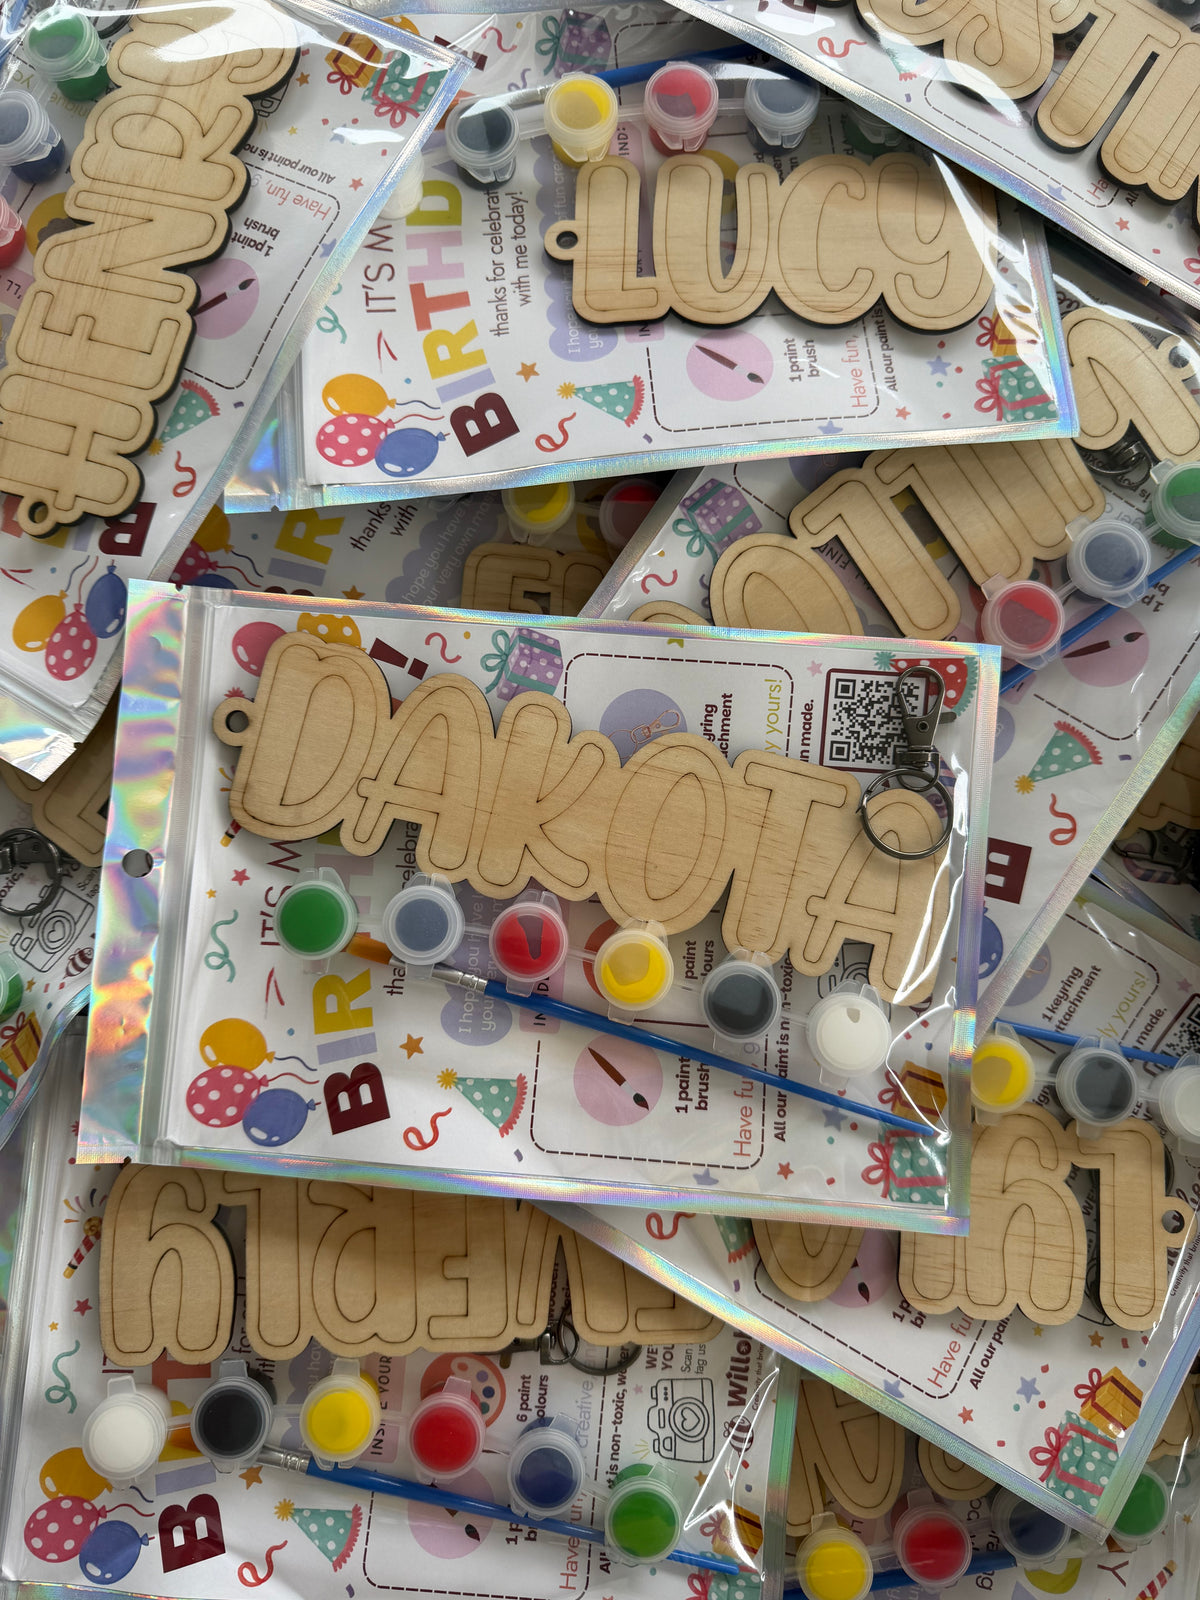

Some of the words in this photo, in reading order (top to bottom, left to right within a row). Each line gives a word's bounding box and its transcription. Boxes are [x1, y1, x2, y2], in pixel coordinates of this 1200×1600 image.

[258, 148, 269, 161] is
[616, 127, 631, 157] IND:
[268, 152, 302, 171] paint
[300, 163, 319, 178] our
[317, 170, 337, 185] All
[265, 178, 291, 206] fun,
[291, 194, 332, 221] Have
[243, 216, 281, 241] brush
[504, 191, 529, 242] today!
[363, 224, 394, 252] M
[584, 160, 985, 322] LUCY
[485, 259, 505, 283] for
[514, 245, 529, 269] me
[362, 263, 397, 313] IT'S
[510, 274, 532, 308] with
[487, 285, 510, 337] thanks
[841, 335, 860, 363] fun,
[874, 320, 894, 352] paint
[783, 337, 805, 374] paint
[802, 339, 821, 379] brush
[880, 353, 895, 374] our
[850, 368, 869, 408] Have
[883, 374, 898, 392] All
[349, 501, 392, 552] thanks
[390, 503, 418, 537] with
[700, 703, 718, 742] yring
[763, 677, 784, 735] yours!
[800, 698, 815, 744] made.
[716, 692, 733, 759] achment
[240, 640, 943, 994] DAKOTA
[681, 939, 699, 980] paint
[701, 938, 715, 979] lours
[1046, 965, 1084, 1016] keyring
[1111, 971, 1150, 1024] yours!
[775, 1027, 791, 1046] is
[1136, 1006, 1168, 1048] made.
[675, 1056, 693, 1102] paint
[775, 1048, 790, 1080] aint
[694, 1063, 711, 1112] brush
[674, 1103, 689, 1114] 1
[776, 1094, 788, 1121] our
[732, 1106, 753, 1158] Have
[773, 1121, 787, 1143] All
[377, 1355, 393, 1392] YOUR
[680, 1347, 694, 1374] Scan
[694, 1357, 709, 1375] tag
[926, 1337, 963, 1389] Have
[968, 1367, 989, 1391] All
[980, 1343, 1000, 1369] our
[517, 1373, 532, 1412] paint
[515, 1412, 529, 1423] 6
[609, 1388, 628, 1463] non-toxic,
[604, 1462, 620, 1478] is
[558, 1536, 581, 1591] Have
